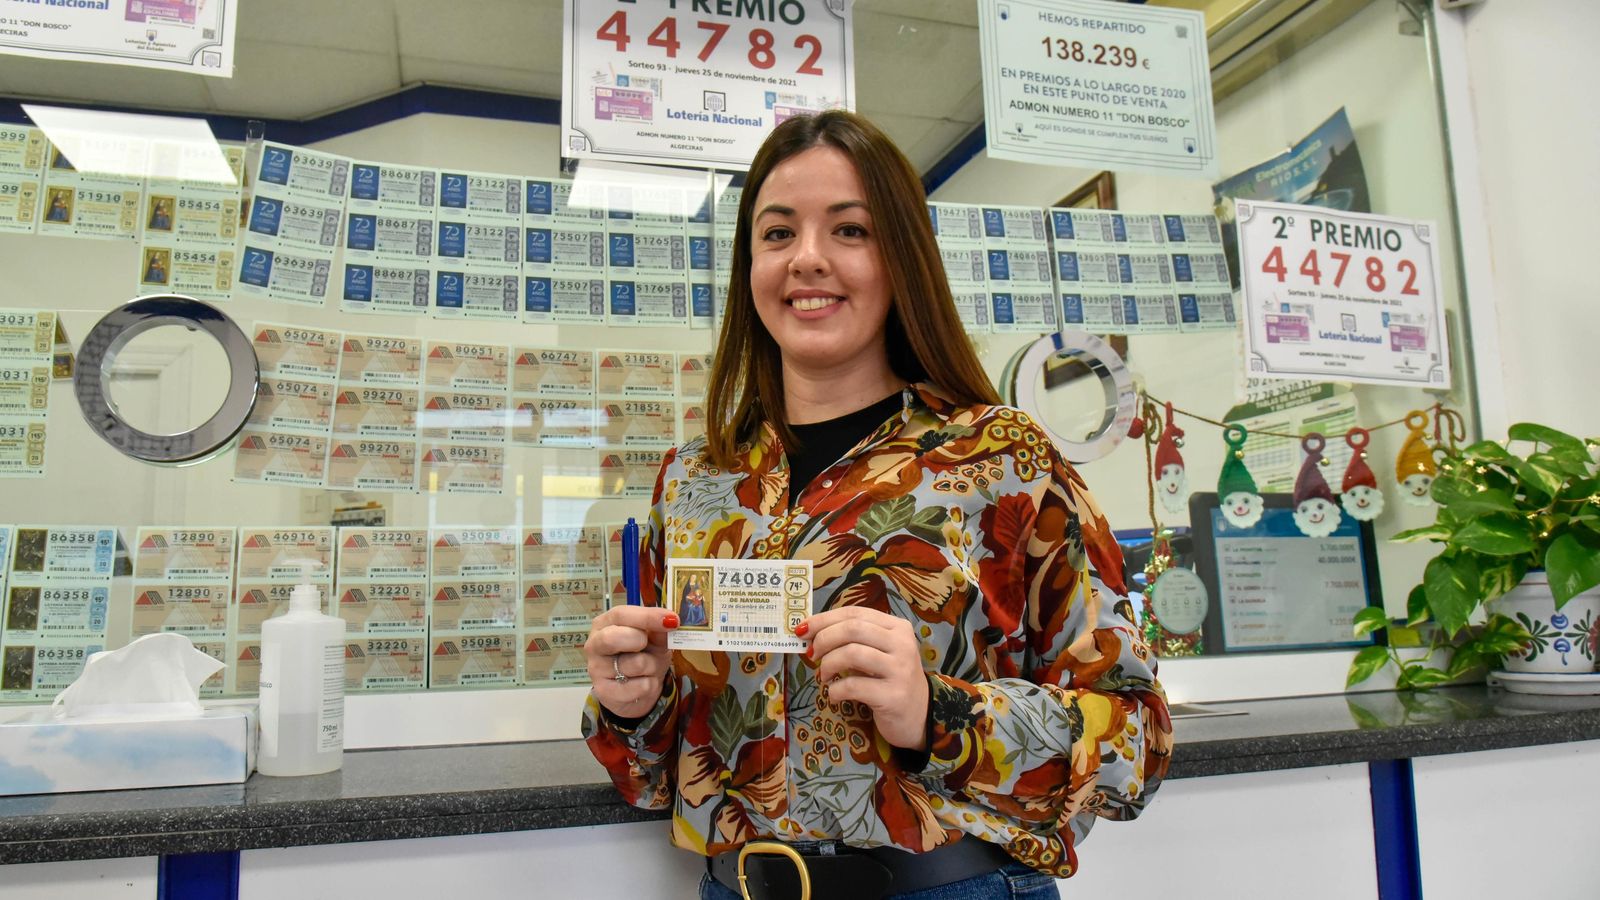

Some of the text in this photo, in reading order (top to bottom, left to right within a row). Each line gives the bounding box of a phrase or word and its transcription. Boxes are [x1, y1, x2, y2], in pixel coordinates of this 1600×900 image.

[1038, 12, 1146, 34] HEMOS REPARTIDO
[596, 10, 824, 76] 44782
[1042, 36, 1150, 70] 138.239 €
[628, 60, 655, 70] Sorteo
[675, 66, 700, 75] jueves
[725, 72, 766, 83] noviembre
[1001, 67, 1186, 99] EN PREMIOS A LO LARGO DE 2020
[1023, 84, 1168, 109] EN ESTE PUNTO DE VENTA
[666, 108, 762, 127] Lotería Nacional
[1009, 100, 1190, 128] ADMON NUMERO 11 "DON BOSCO"
[293, 155, 332, 169] 63639
[381, 169, 419, 180] 88687
[469, 178, 505, 188] 73122
[78, 191, 121, 203] 51910
[179, 200, 220, 211] 85454
[284, 205, 323, 218] 63639
[378, 219, 415, 229] 88687
[467, 227, 503, 237] 73122
[553, 233, 588, 241] 75507
[1272, 216, 1402, 252] 2º PREMIO
[174, 252, 216, 263] 85454
[274, 256, 314, 270] 63639
[374, 269, 413, 279] 88687
[1262, 246, 1420, 296] 44782
[465, 276, 503, 286] 73122
[553, 281, 588, 289] 75507
[284, 330, 324, 341] 65074
[1349, 333, 1382, 344] Nacional
[367, 339, 406, 348] 99270
[455, 345, 492, 355] 80651
[541, 352, 577, 361] 66747
[277, 382, 317, 393] 65074
[363, 391, 402, 400] 99270
[452, 396, 490, 405] 80651
[626, 403, 660, 411] 21852
[269, 436, 310, 446] 65074
[360, 443, 399, 452] 99270
[450, 448, 488, 457] 80651
[50, 533, 95, 542] 86358
[173, 532, 215, 542] 12890
[274, 532, 315, 541] 46916
[372, 533, 411, 541] 32220
[718, 572, 782, 585] 74086
[370, 586, 409, 595] 32220
[461, 584, 500, 593] 95098
[551, 581, 587, 590] 85721
[44, 591, 89, 600] 86358
[168, 588, 210, 598] 12890
[367, 641, 407, 650] 32220
[461, 638, 500, 647] 95098
[38, 650, 83, 659] 86358
